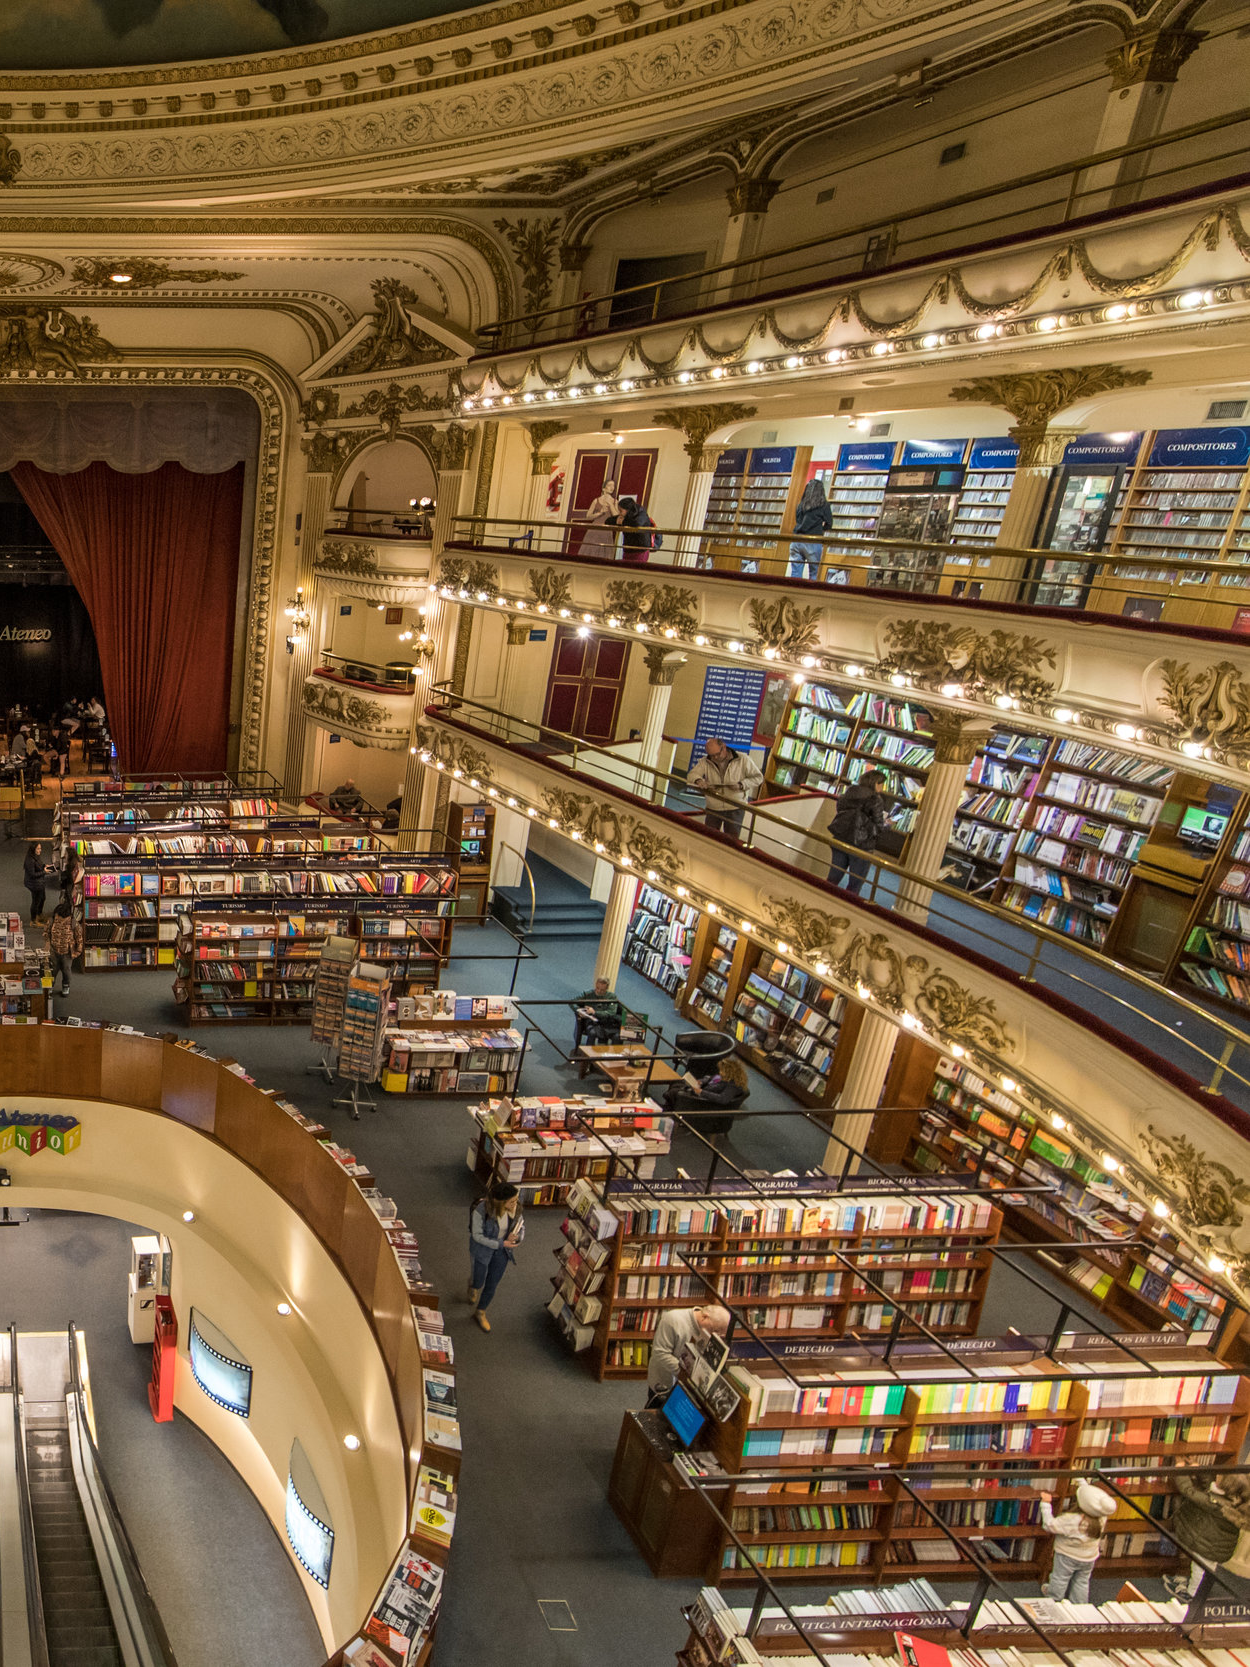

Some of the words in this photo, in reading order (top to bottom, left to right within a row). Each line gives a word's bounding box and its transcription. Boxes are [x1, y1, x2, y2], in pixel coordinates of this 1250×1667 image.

[1068, 446, 1125, 454] COMPOSITORES
[1167, 442, 1237, 452] COMPOSITORES
[911, 451, 953, 459] COMPOSITORES
[868, 1177, 916, 1185] BIOGRFÍAS
[1151, 1335, 1178, 1344] VIAJE
[784, 1345, 834, 1354] DERECHO
[946, 1340, 996, 1350] DERECHO
[774, 1620, 836, 1631] POITICA
[840, 1617, 950, 1629] INTERNACIONAL
